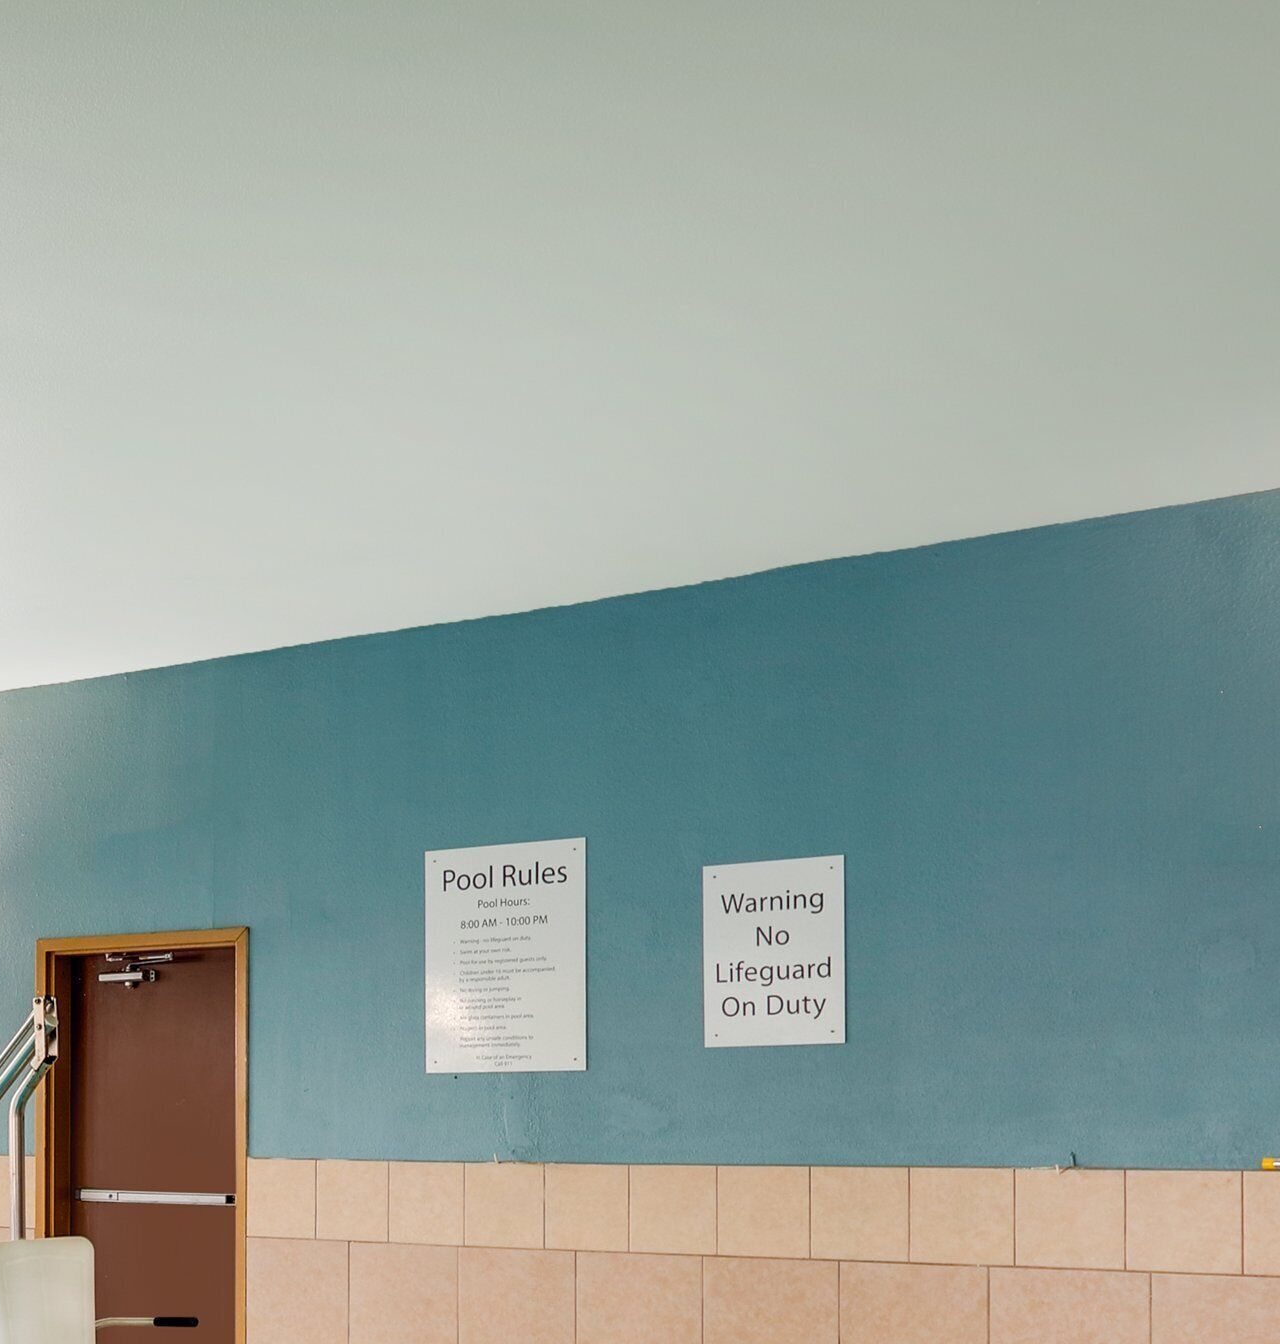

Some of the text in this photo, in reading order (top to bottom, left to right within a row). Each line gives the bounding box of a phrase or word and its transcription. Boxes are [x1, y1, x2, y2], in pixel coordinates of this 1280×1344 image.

[443, 861, 568, 892] Pool Rules
[477, 898, 530, 909] Pool Hours:
[721, 889, 824, 914] Warning
[460, 919, 480, 929] 8:00
[482, 918, 497, 928] AM
[506, 916, 530, 926] 10:00
[533, 915, 548, 924] PM
[756, 926, 790, 947] No
[716, 956, 832, 987] Lifeguard
[722, 994, 826, 1020] On Duty
